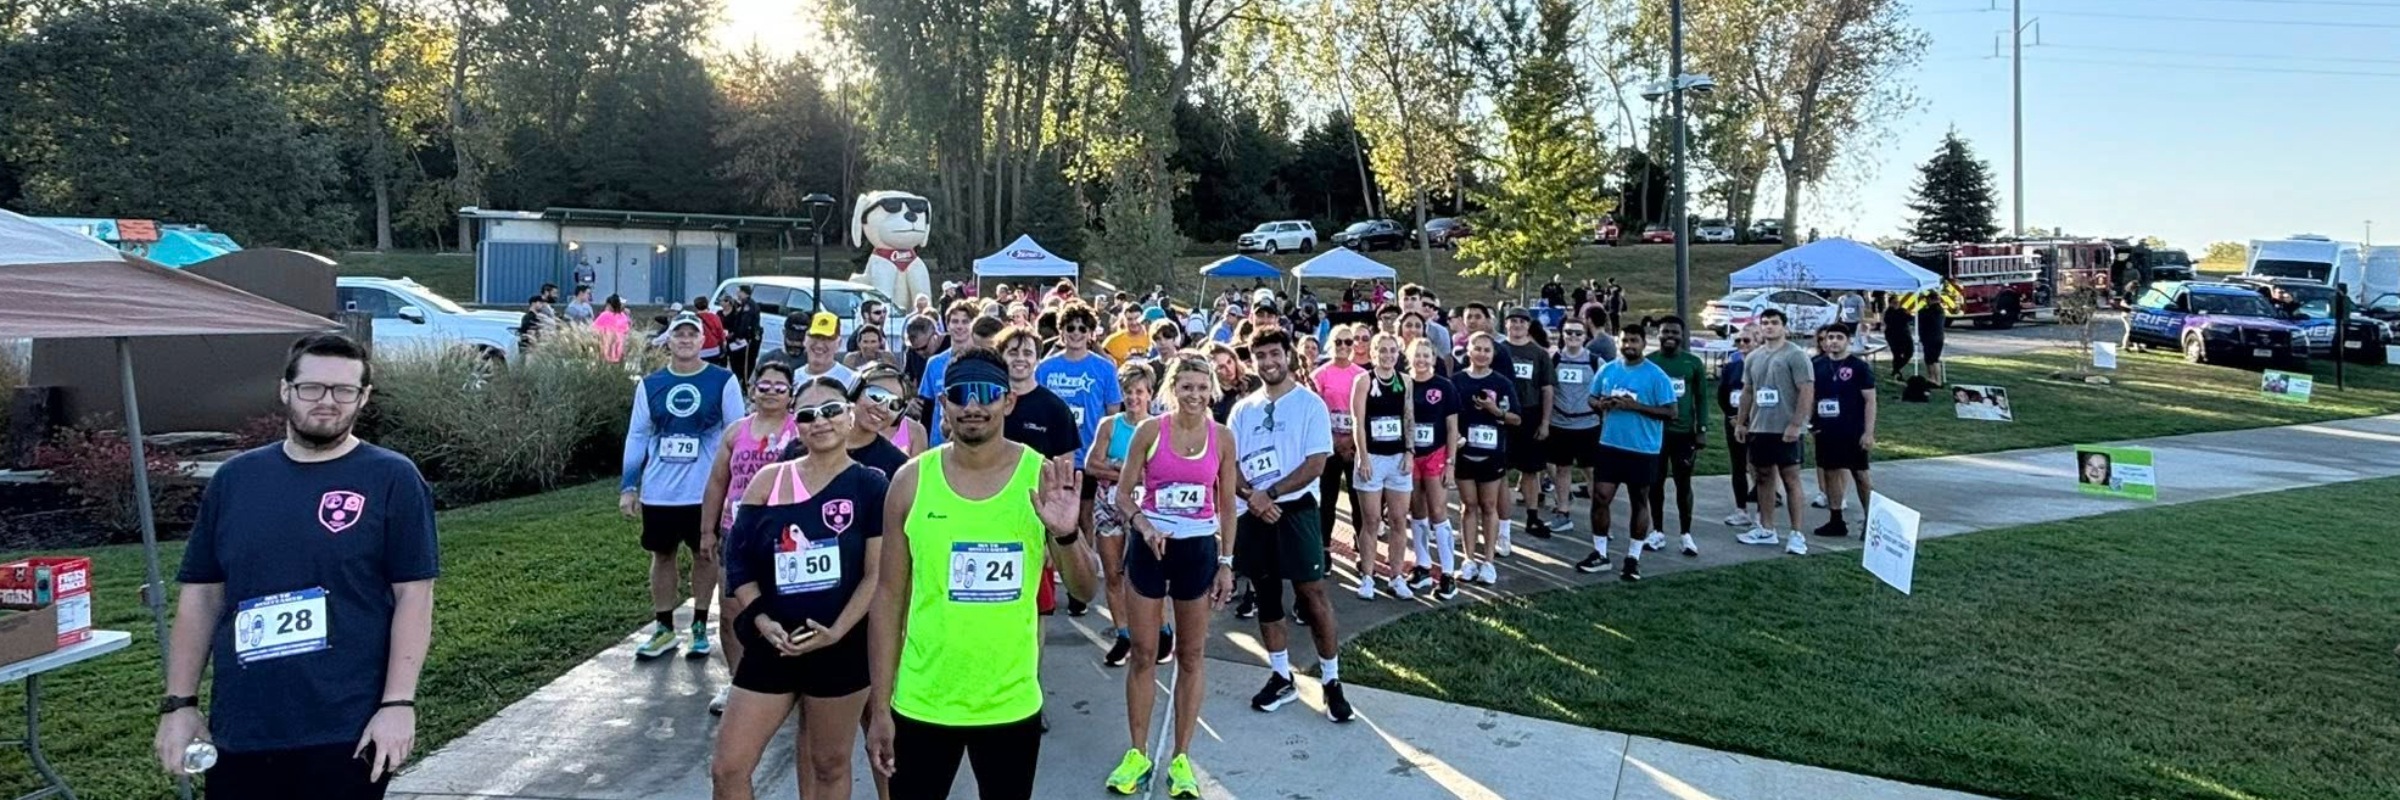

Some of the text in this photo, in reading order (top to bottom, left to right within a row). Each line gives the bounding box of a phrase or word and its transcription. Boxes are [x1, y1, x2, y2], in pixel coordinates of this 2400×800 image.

[1563, 371, 1577, 380] 22
[1386, 423, 1398, 433] 56
[1417, 430, 1429, 439] 57
[1483, 432, 1493, 440] 97
[678, 442, 694, 453] 79
[1257, 456, 1272, 471] 21
[1180, 490, 1198, 503] 74
[806, 554, 831, 574] 50
[986, 560, 1014, 581] 24
[277, 608, 313, 635] 28
